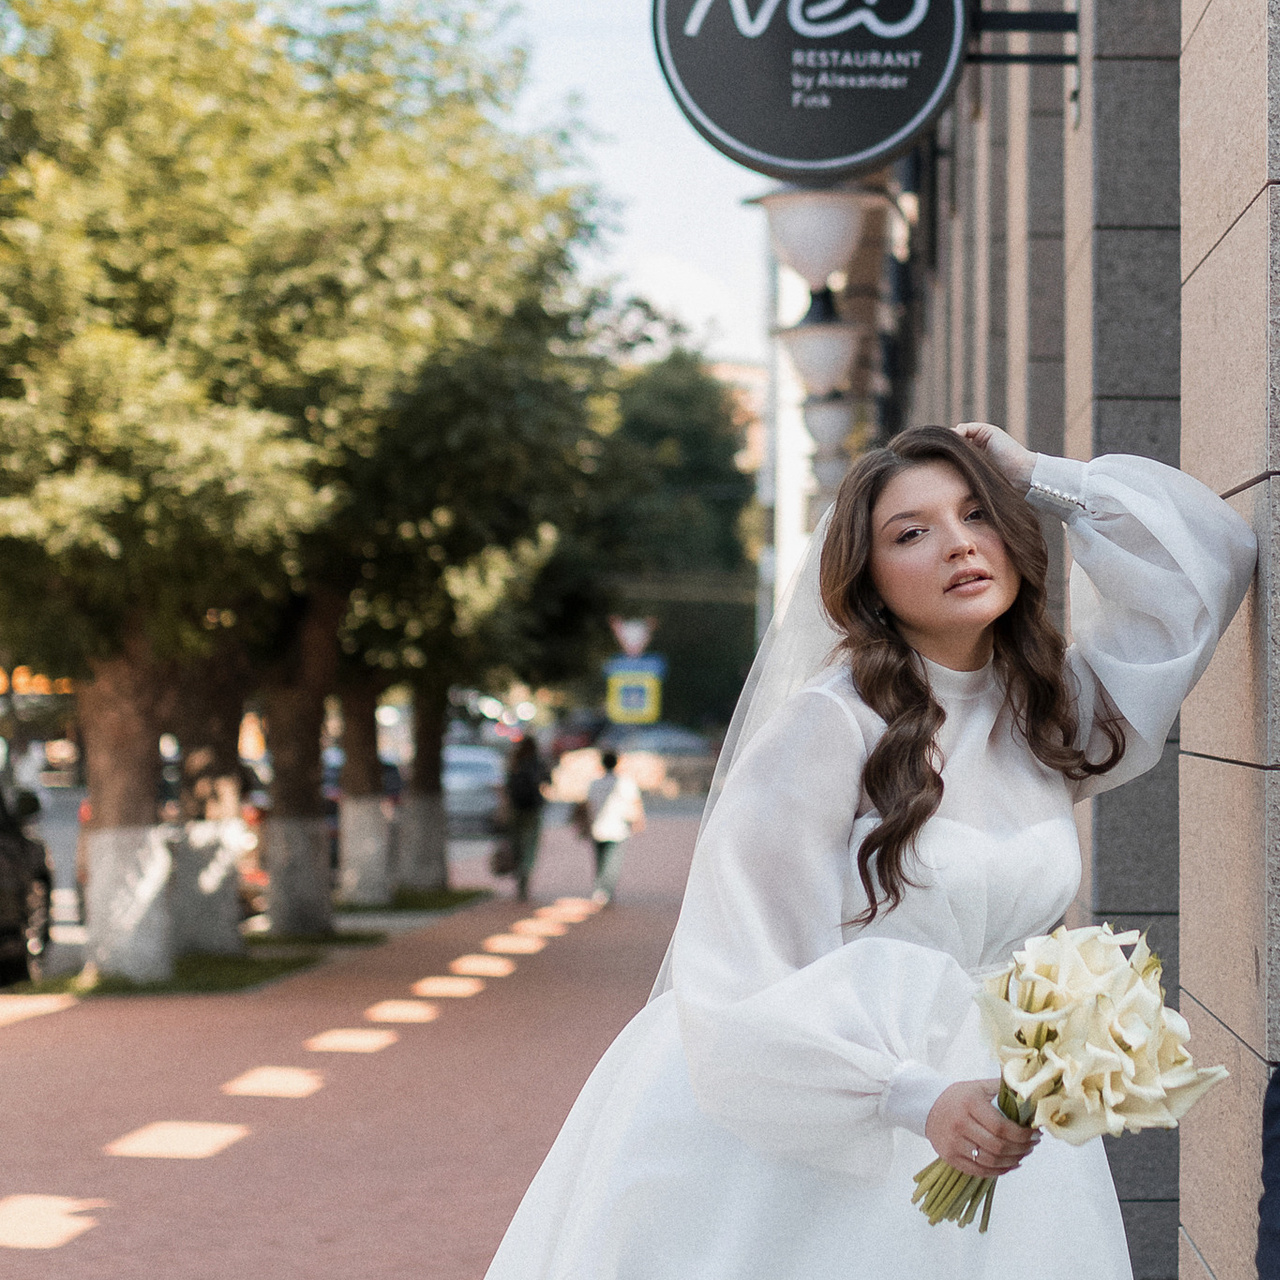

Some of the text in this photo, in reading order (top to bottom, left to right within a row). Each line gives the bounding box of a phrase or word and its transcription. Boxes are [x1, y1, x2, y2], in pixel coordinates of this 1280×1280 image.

[791, 50, 922, 68] RESTAURANT
[791, 71, 908, 91] by Alexander
